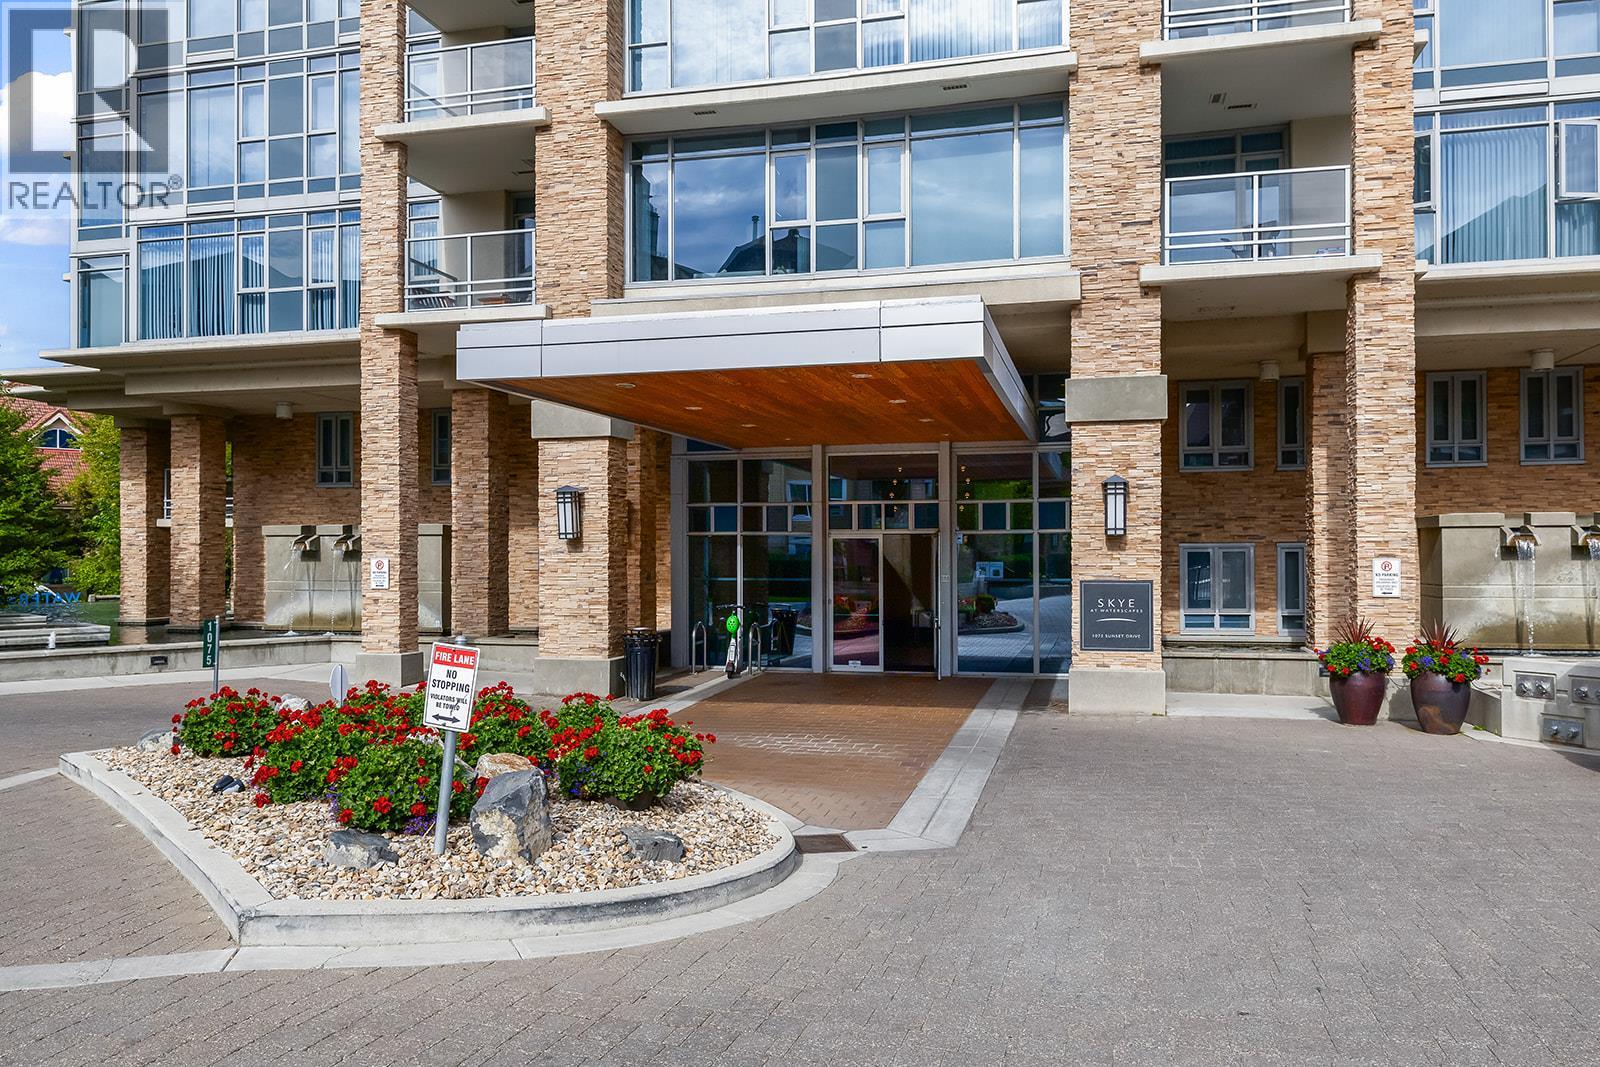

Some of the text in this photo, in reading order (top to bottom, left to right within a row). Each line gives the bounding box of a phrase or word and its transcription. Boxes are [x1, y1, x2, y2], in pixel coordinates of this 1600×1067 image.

[1097, 598, 1135, 608] SKYE
[435, 651, 475, 665] FIRE LANE
[446, 669, 458, 680] NO
[431, 679, 470, 693] STOPPING
[430, 693, 468, 705] VIOLATORS WILL
